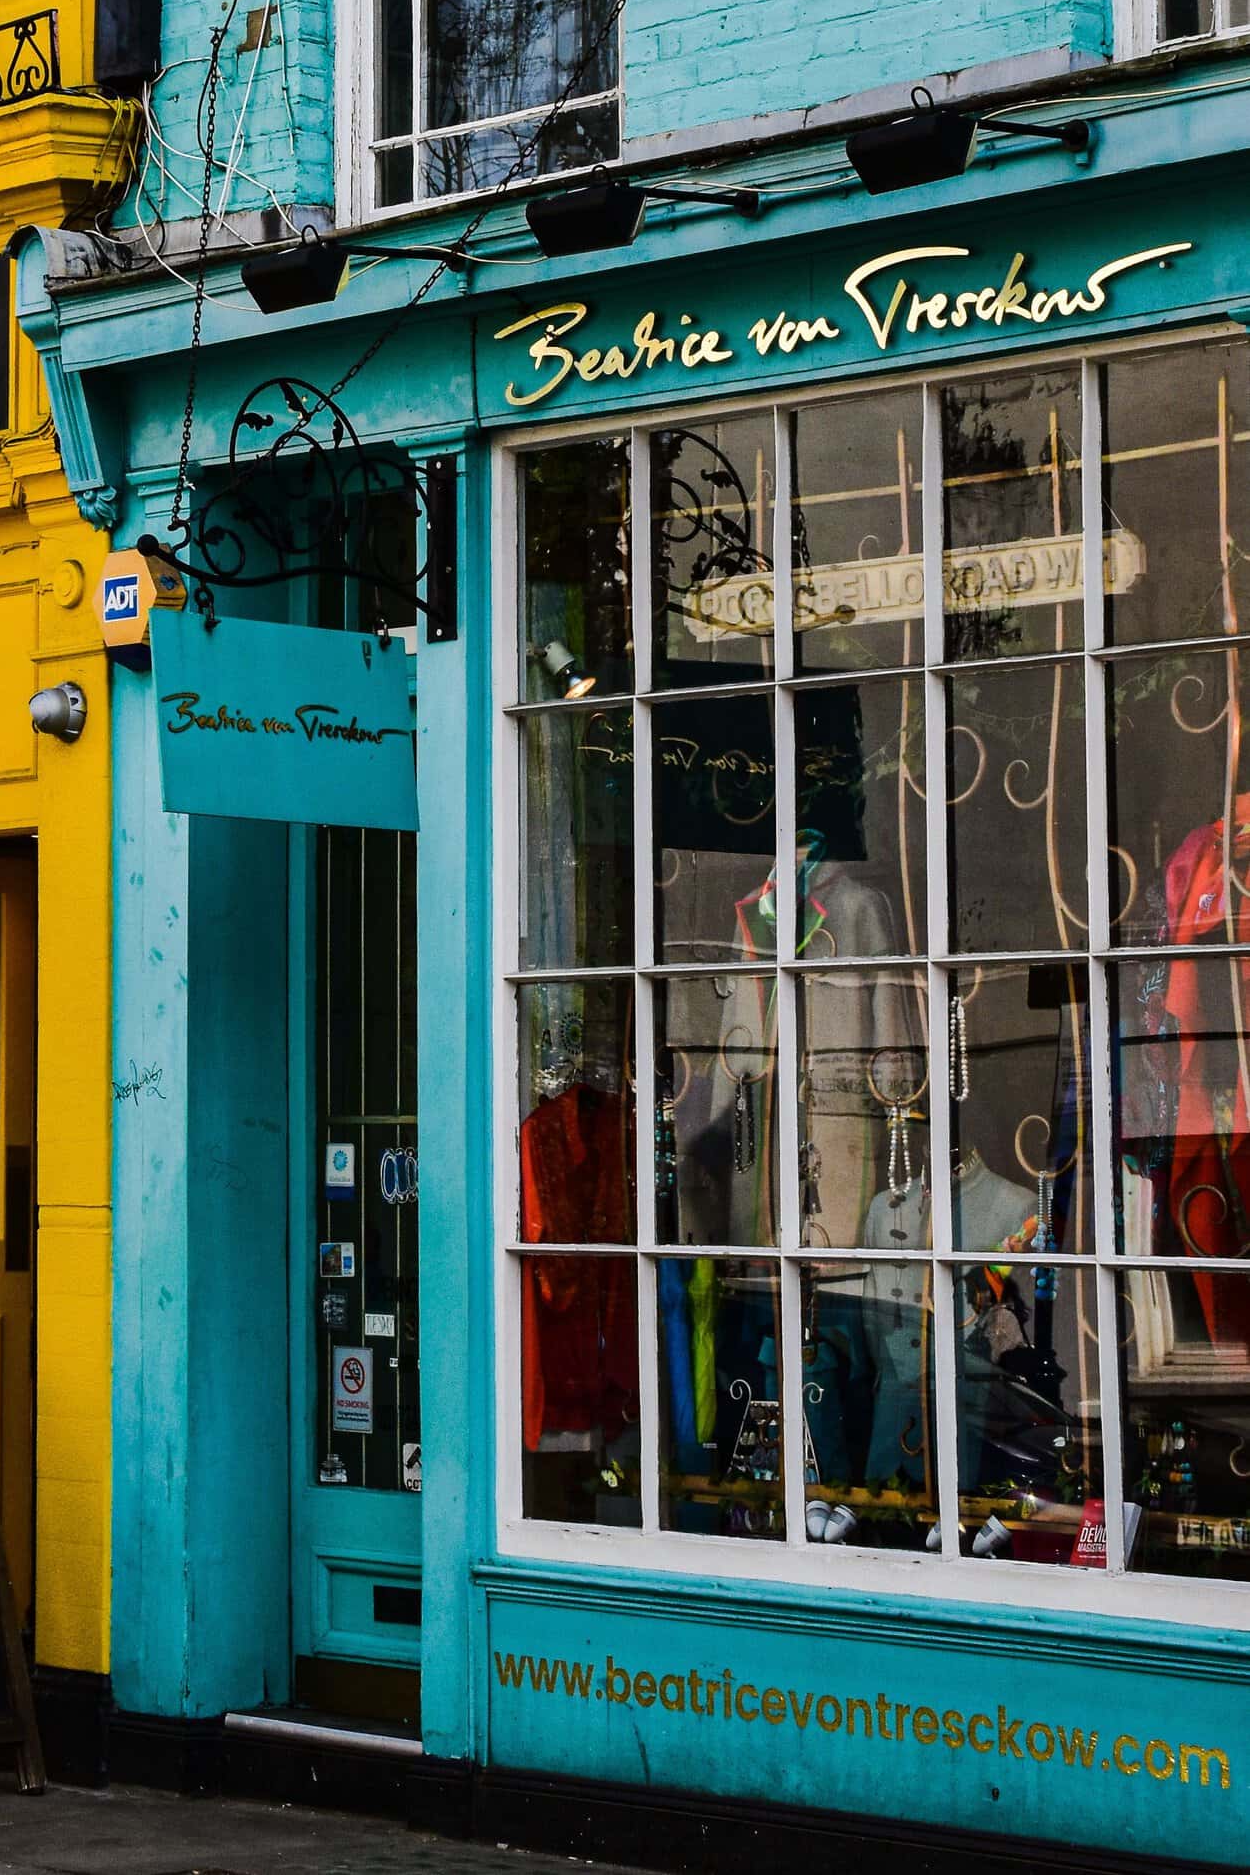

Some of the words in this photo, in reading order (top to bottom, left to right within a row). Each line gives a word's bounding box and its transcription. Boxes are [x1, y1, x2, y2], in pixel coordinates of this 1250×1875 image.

[493, 301, 733, 407] Beatrice
[105, 585, 138, 613] ADT
[699, 565, 925, 625] POROBELLO
[942, 551, 1036, 601] ROAD
[493, 1650, 1232, 1790] www.beatricevontresckow.com
